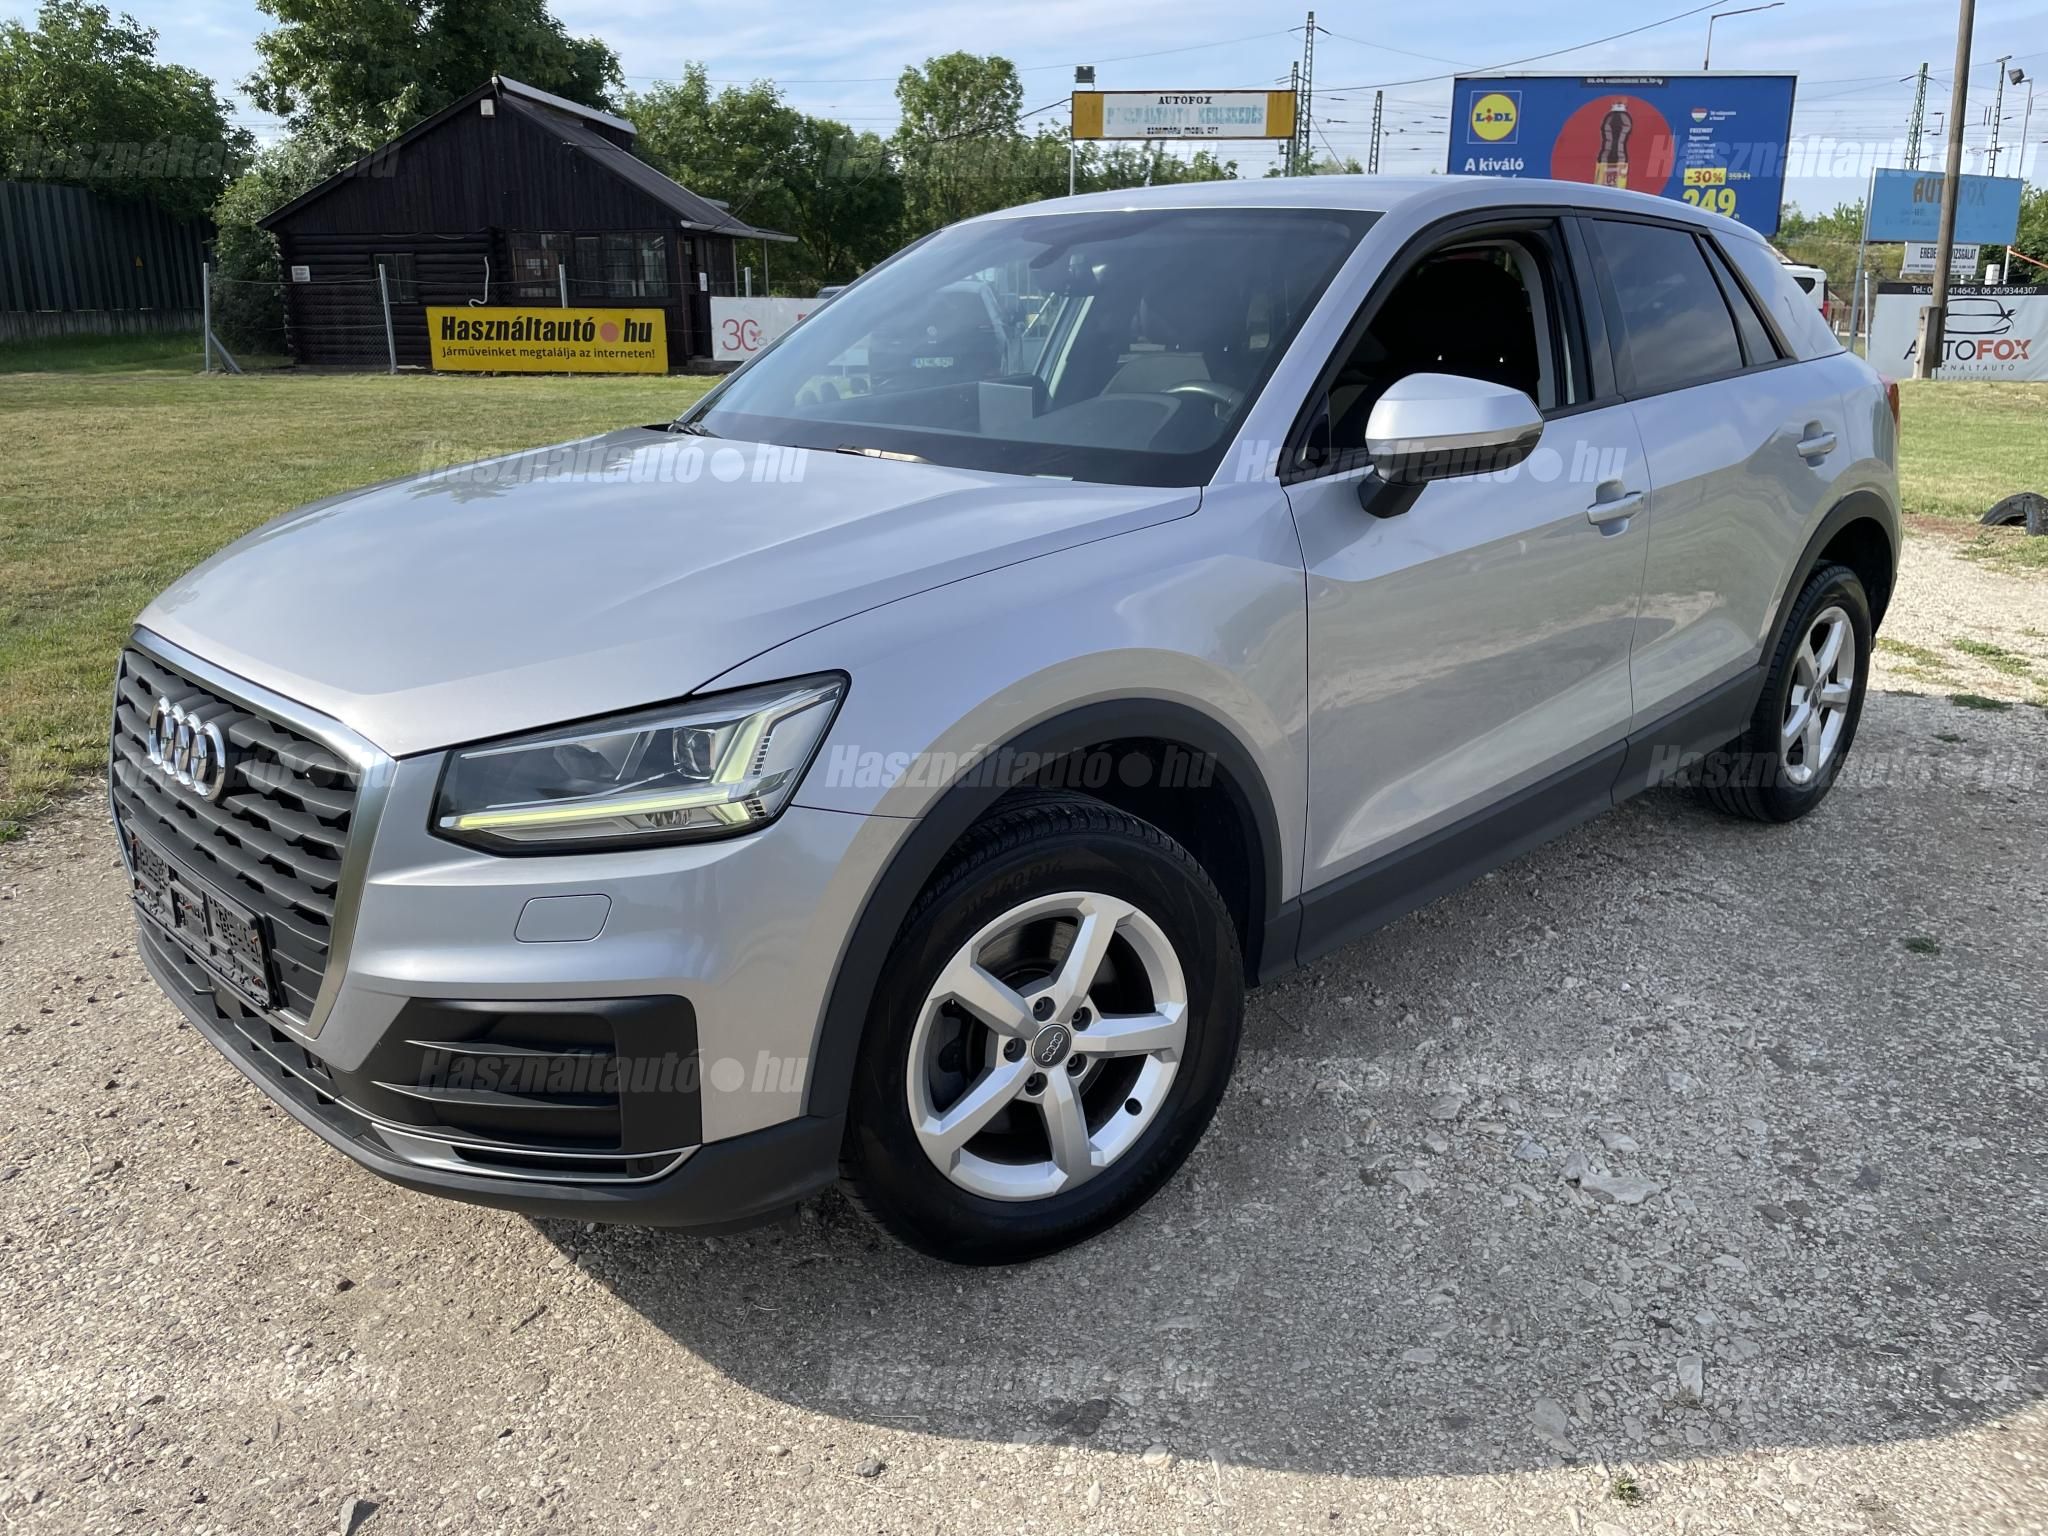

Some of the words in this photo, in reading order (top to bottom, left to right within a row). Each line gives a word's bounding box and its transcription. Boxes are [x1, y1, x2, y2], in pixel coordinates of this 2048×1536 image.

[1464, 158, 1476, 171] A
[1479, 157, 1524, 171] kiváló
[1688, 170, 1723, 183] -30%
[1682, 188, 1736, 218] 249
[1912, 285, 1926, 294] Tel.:
[1981, 286, 1991, 294] 06
[1992, 286, 2037, 295] 20/9344307
[441, 316, 596, 342] Használtautó
[624, 318, 652, 342] hu
[442, 347, 516, 358] Járműveinket
[519, 347, 576, 359] megtalálja
[579, 350, 591, 358] az
[594, 348, 655, 359] interneten!
[1904, 339, 2032, 360] ATOFOX
